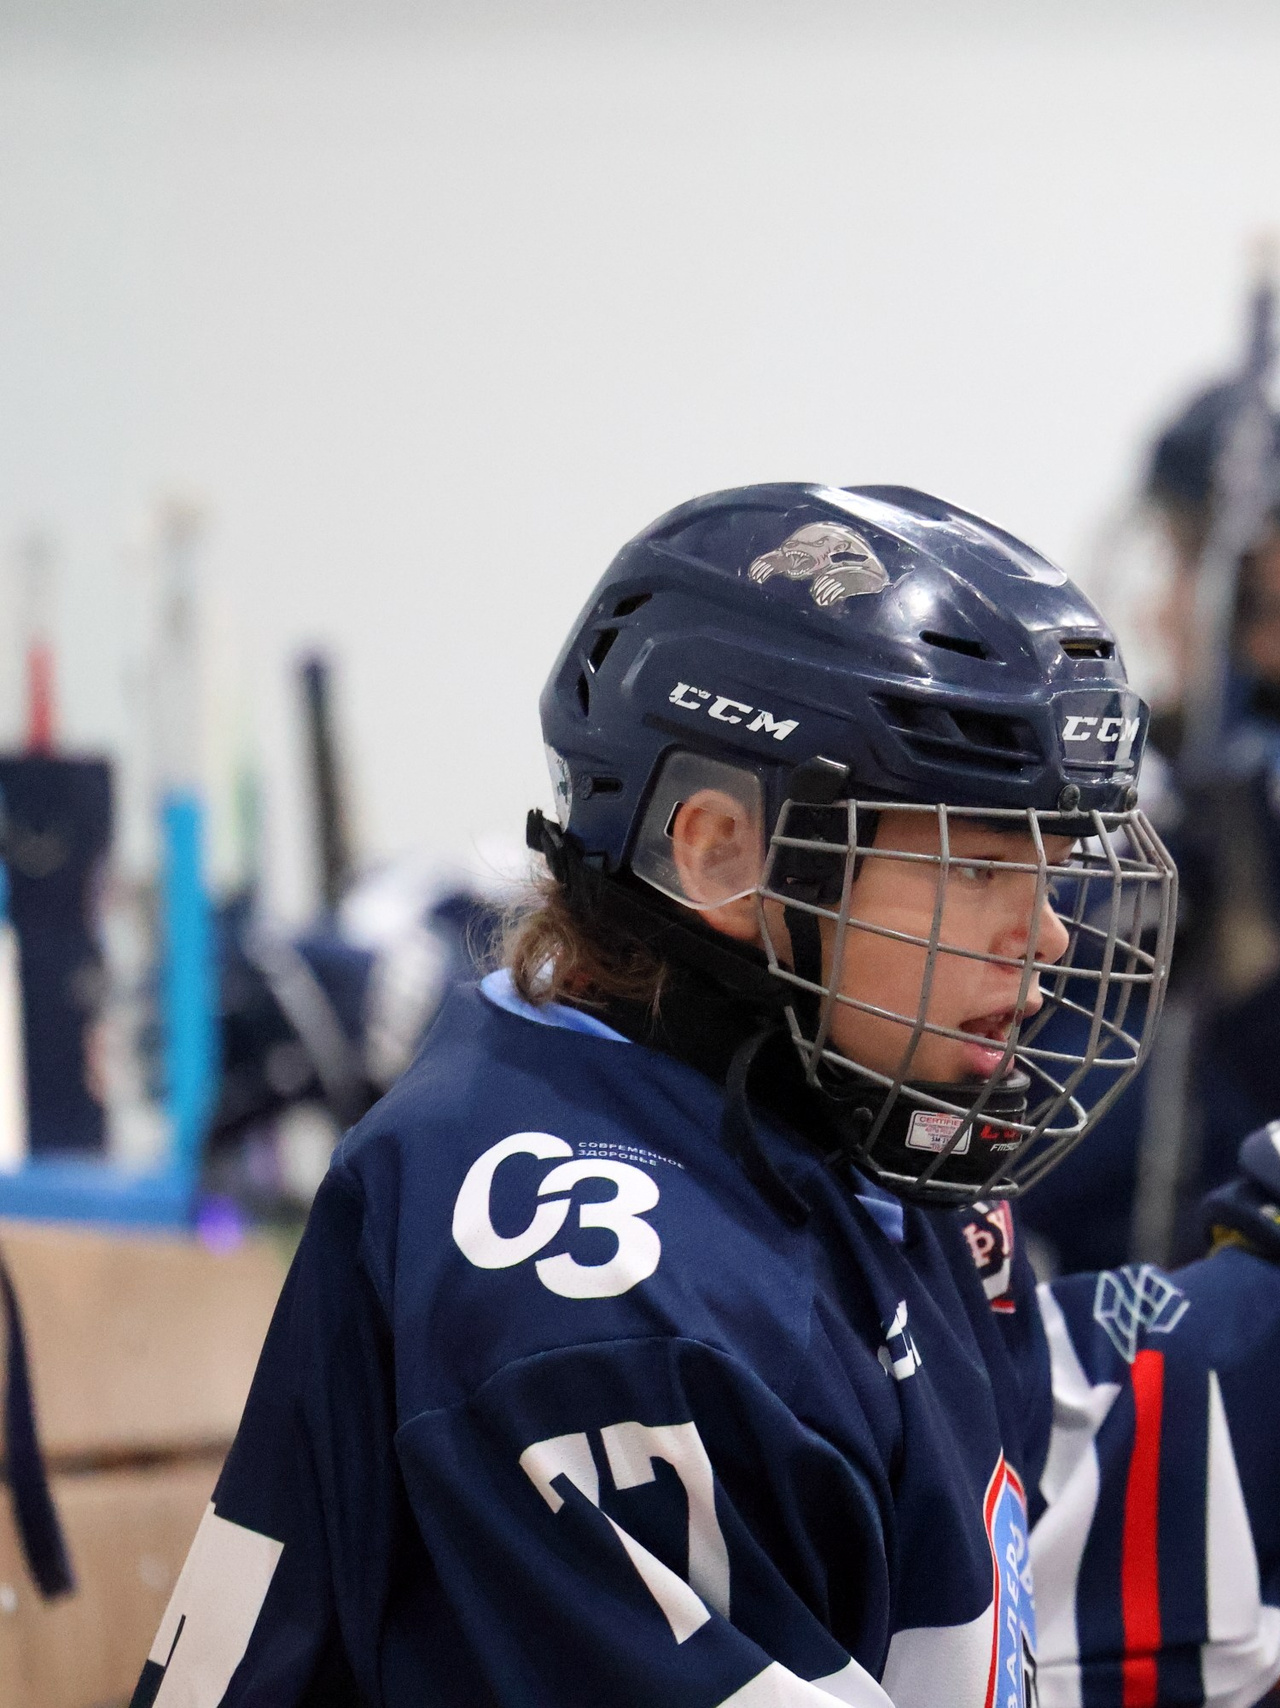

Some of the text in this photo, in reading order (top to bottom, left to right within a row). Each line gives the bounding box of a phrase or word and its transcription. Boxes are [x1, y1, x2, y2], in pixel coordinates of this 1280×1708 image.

[668, 681, 800, 741] CCM
[1062, 715, 1141, 742] CCM
[919, 1115, 962, 1127] CERTIFIE
[578, 1149, 658, 1167] ЗДОРОВЬЕ
[518, 1418, 731, 1646] 77
